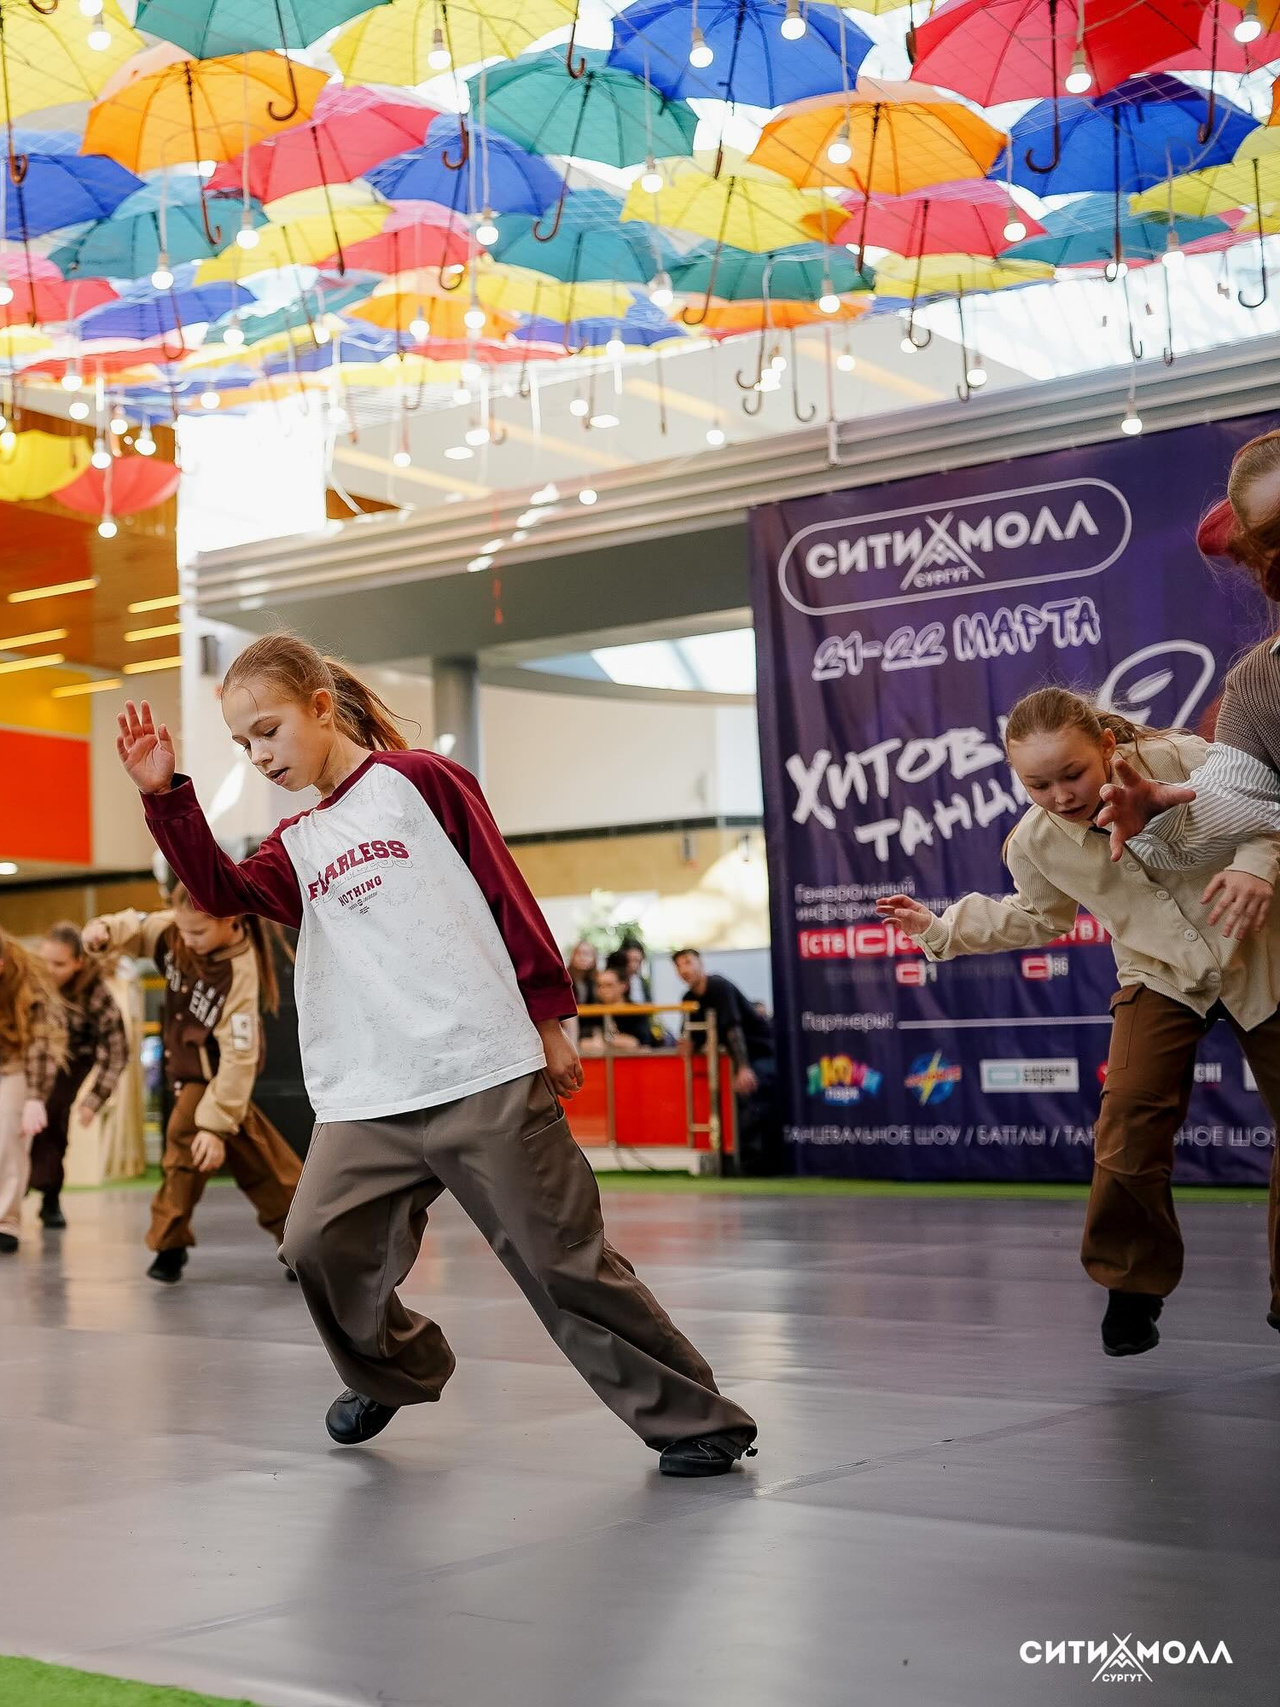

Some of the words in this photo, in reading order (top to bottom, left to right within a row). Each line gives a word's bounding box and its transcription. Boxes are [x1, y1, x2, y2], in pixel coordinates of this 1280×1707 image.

[806, 527, 923, 579] СИТИ
[958, 500, 1100, 553] МОЛЛ
[913, 565, 970, 589] СУРГУТ
[811, 621, 948, 682] 21-22
[953, 596, 1102, 661] МАРТА
[785, 715, 1008, 829] ХИТОВ
[338, 875, 382, 907] NOTHING
[783, 1125, 912, 1146] ТАНЦЕВАЛЬНОЕ
[914, 1124, 961, 1146] ШОУ
